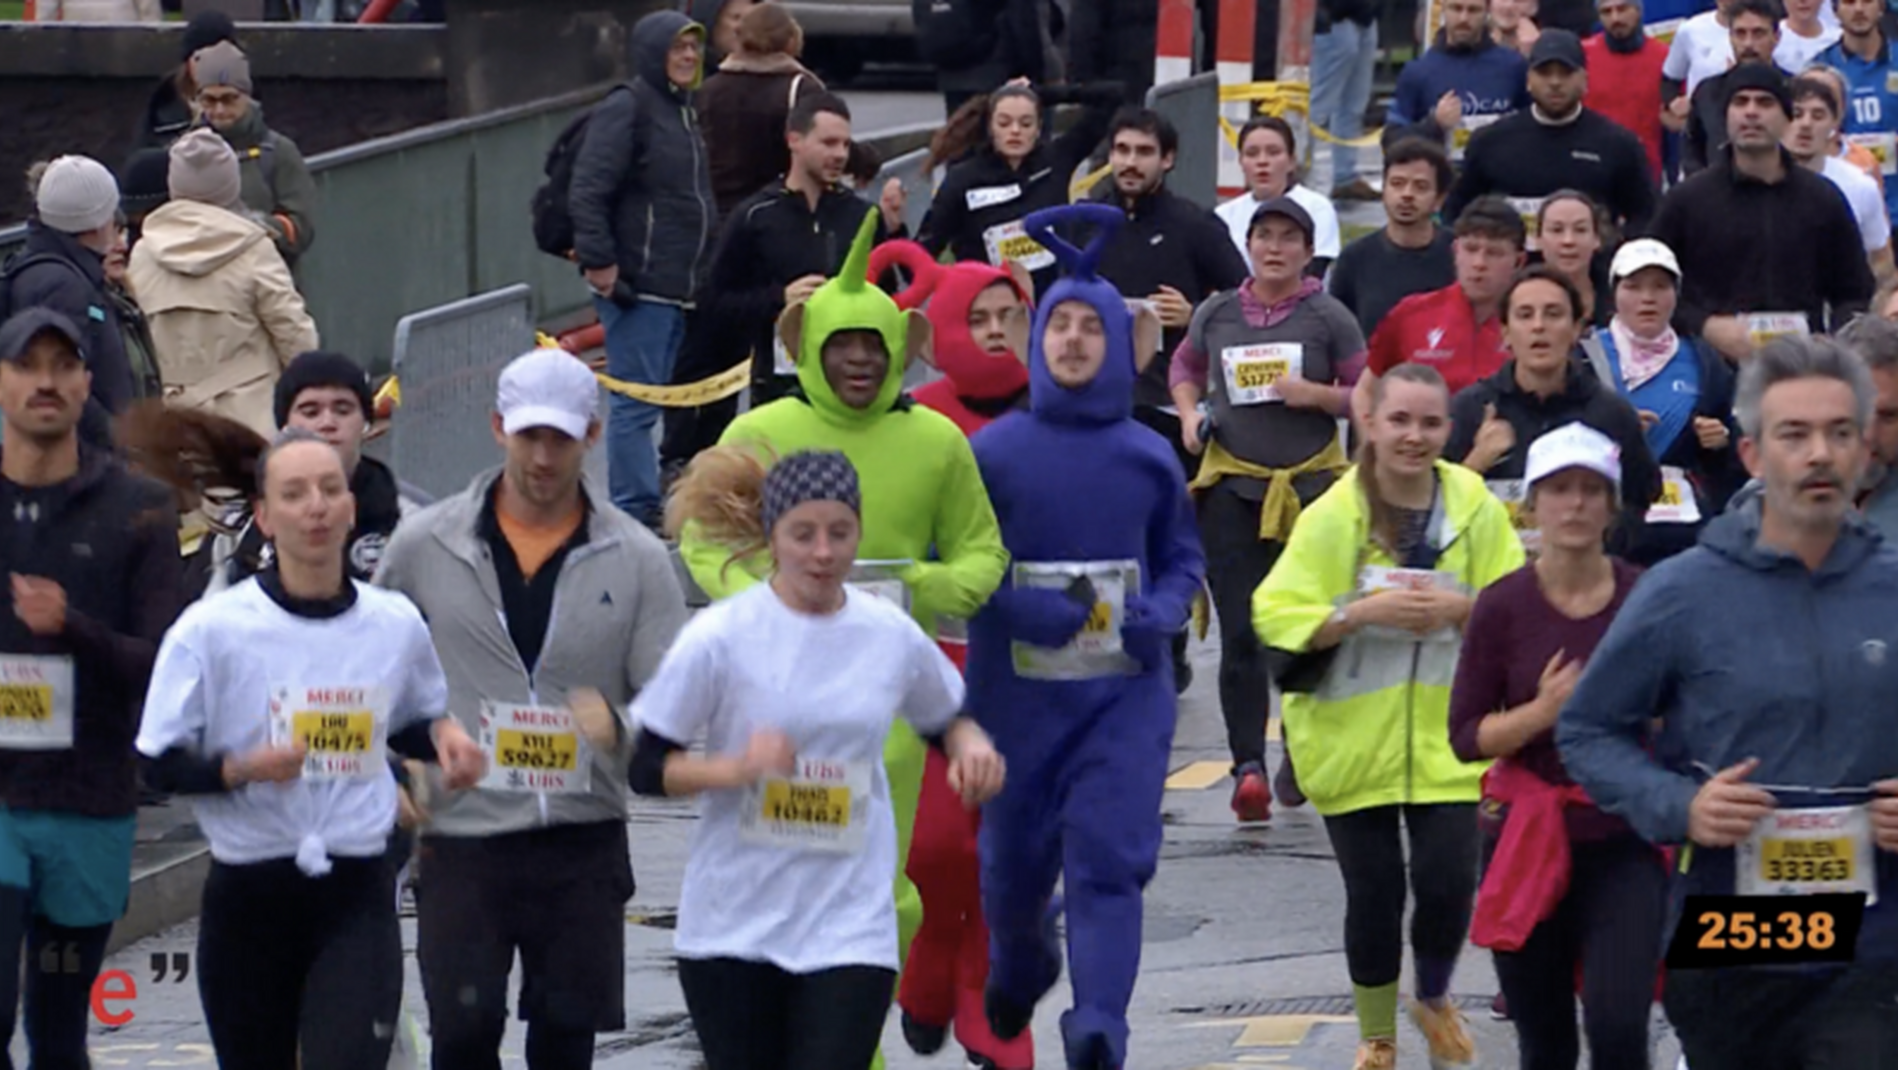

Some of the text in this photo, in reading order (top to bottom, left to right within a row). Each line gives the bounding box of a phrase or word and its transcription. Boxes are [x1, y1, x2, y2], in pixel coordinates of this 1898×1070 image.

[1853, 96, 1881, 124] 10
[1243, 347, 1283, 359] MERCI
[306, 687, 364, 705] MERCI
[320, 714, 349, 729] LOU
[511, 708, 571, 727] MERCI
[304, 731, 367, 753] 10475
[521, 733, 554, 750] KYLE
[326, 757, 362, 774] UBS
[803, 761, 845, 780] UBS
[526, 771, 566, 788] UBS
[1781, 840, 1837, 858] JULIEN
[1766, 858, 1850, 882] 33363
